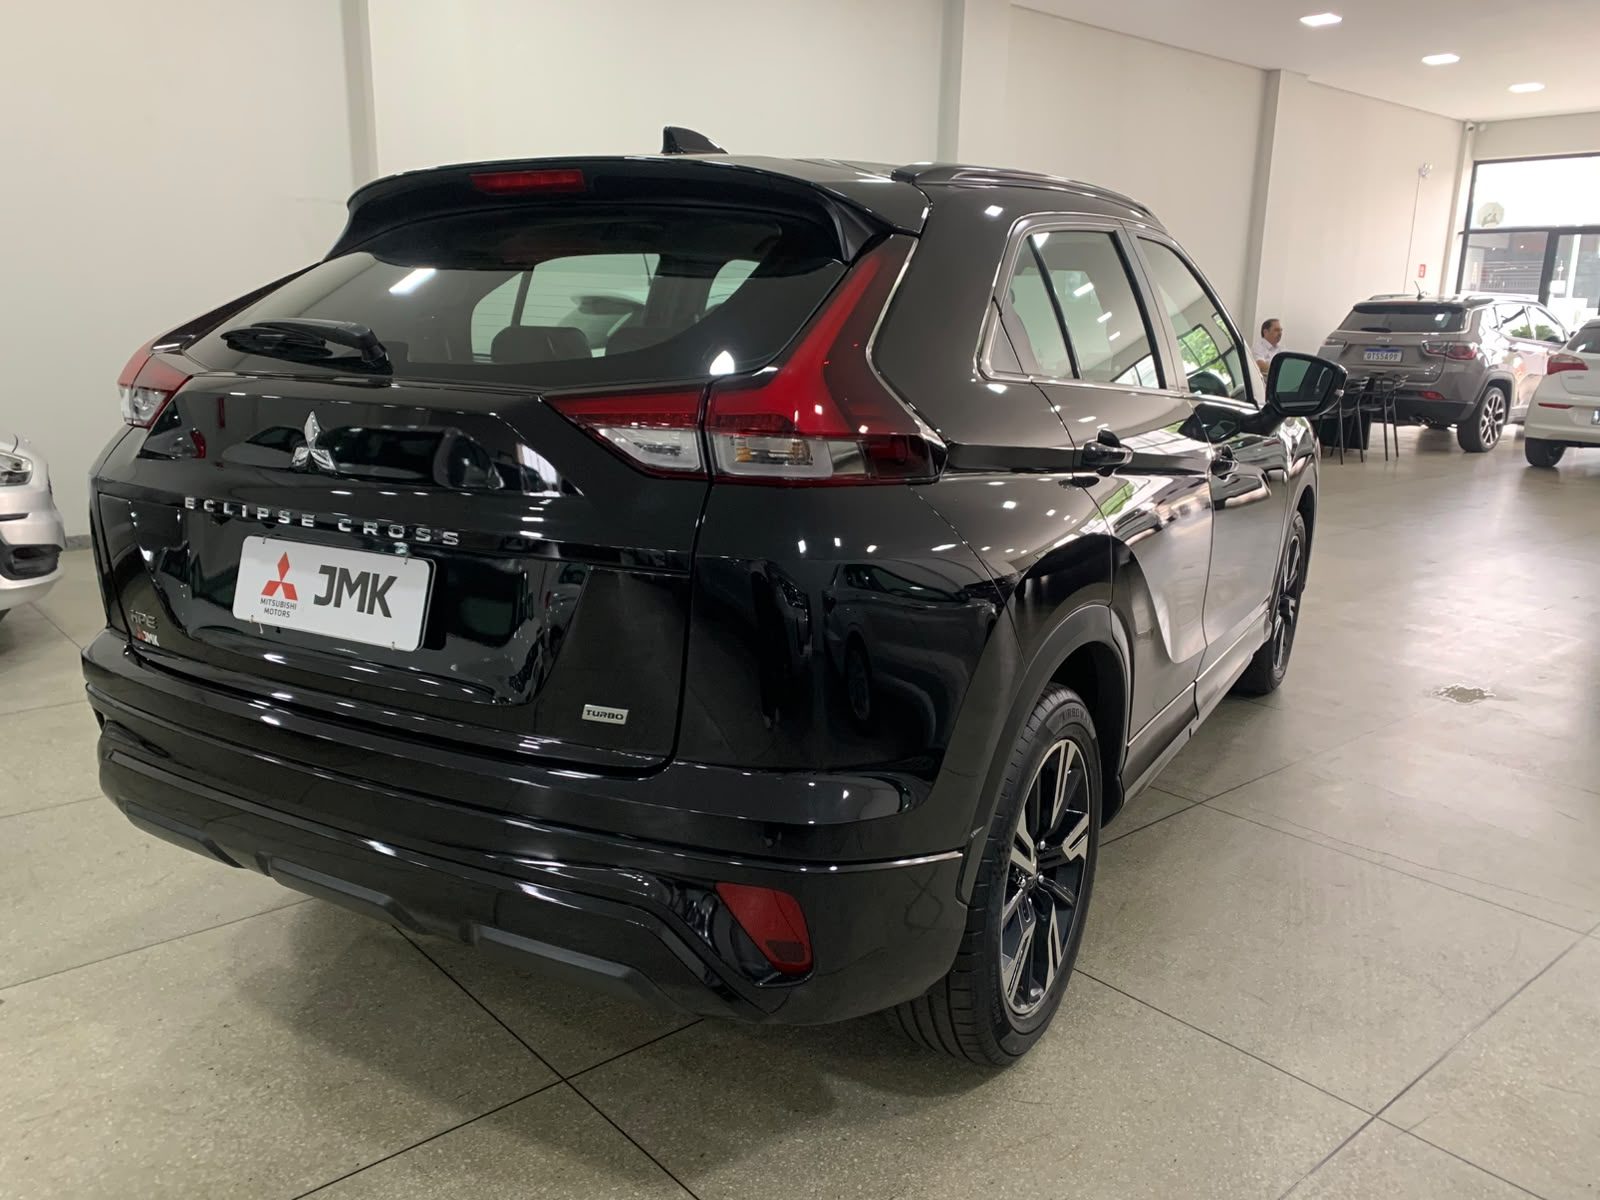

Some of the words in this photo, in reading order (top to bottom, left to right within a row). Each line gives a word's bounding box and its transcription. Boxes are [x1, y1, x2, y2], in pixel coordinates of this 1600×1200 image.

[184, 496, 316, 528] ECLIPSE
[337, 518, 461, 546] CROSS
[313, 564, 398, 619] JMK
[260, 597, 297, 611] MITSUBISHI
[264, 606, 291, 619] MOTORS
[586, 709, 624, 720] TURBO
